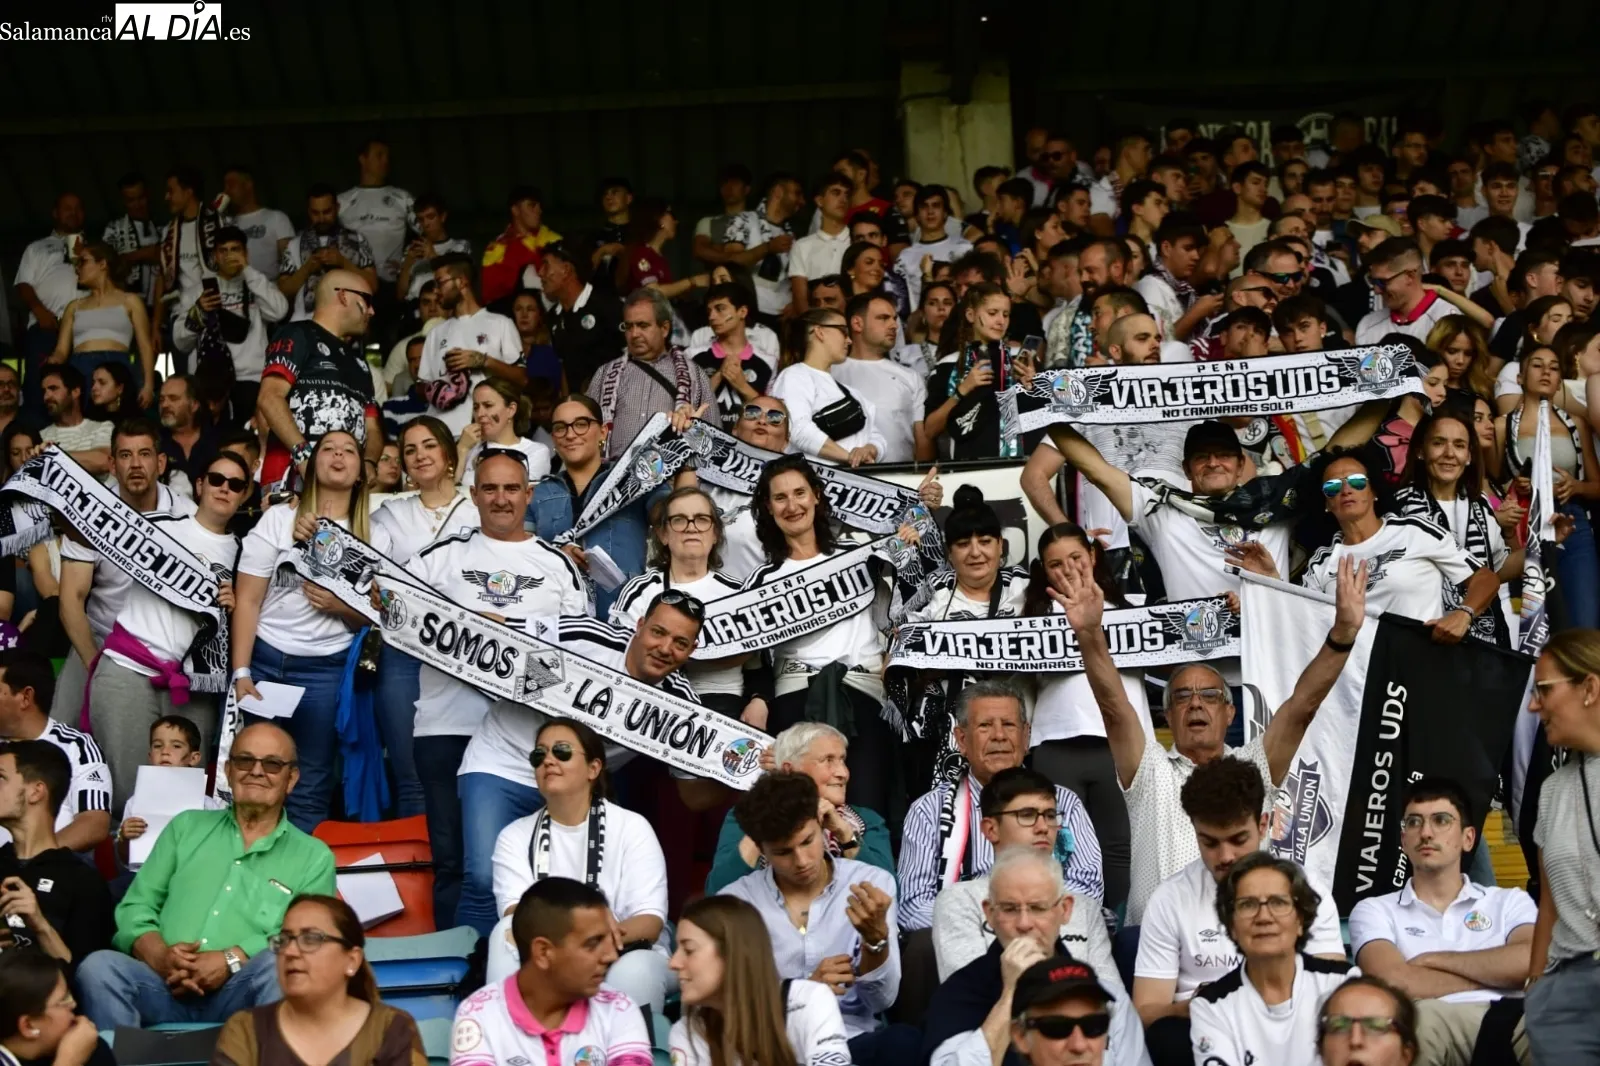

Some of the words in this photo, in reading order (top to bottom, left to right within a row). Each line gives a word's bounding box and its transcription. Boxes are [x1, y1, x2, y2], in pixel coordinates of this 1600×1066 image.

[1109, 367, 1277, 409] VIAJEROS
[1275, 363, 1346, 397] UDS
[1197, 361, 1249, 374] PEÑA
[1162, 409, 1181, 418] NO
[1183, 403, 1258, 417] CAMINARAS
[1260, 401, 1294, 412] SOLA
[113, 501, 155, 536] PEÑA
[843, 486, 901, 523] UDS
[37, 454, 165, 571] VIAJEROS
[159, 553, 218, 608] UDS
[62, 504, 77, 522] NO
[77, 520, 133, 572] CAMINARAS
[134, 568, 163, 592] SOLA
[758, 574, 806, 598] PEÑA
[741, 638, 758, 650] NO
[760, 615, 827, 646] CAMINARAS
[828, 602, 859, 621] SOLA
[1013, 617, 1067, 630] PEÑA
[418, 612, 520, 679] SOMOS
[975, 660, 994, 670] NO
[996, 659, 1075, 671] CAMINARAS
[571, 678, 614, 720] LA
[623, 698, 719, 760] UNIÓN
[1299, 778, 1318, 823] UNION
[1355, 750, 1394, 893] VIAJEROS
[1379, 681, 1408, 740] UDS
[1295, 826, 1309, 862] HALA
